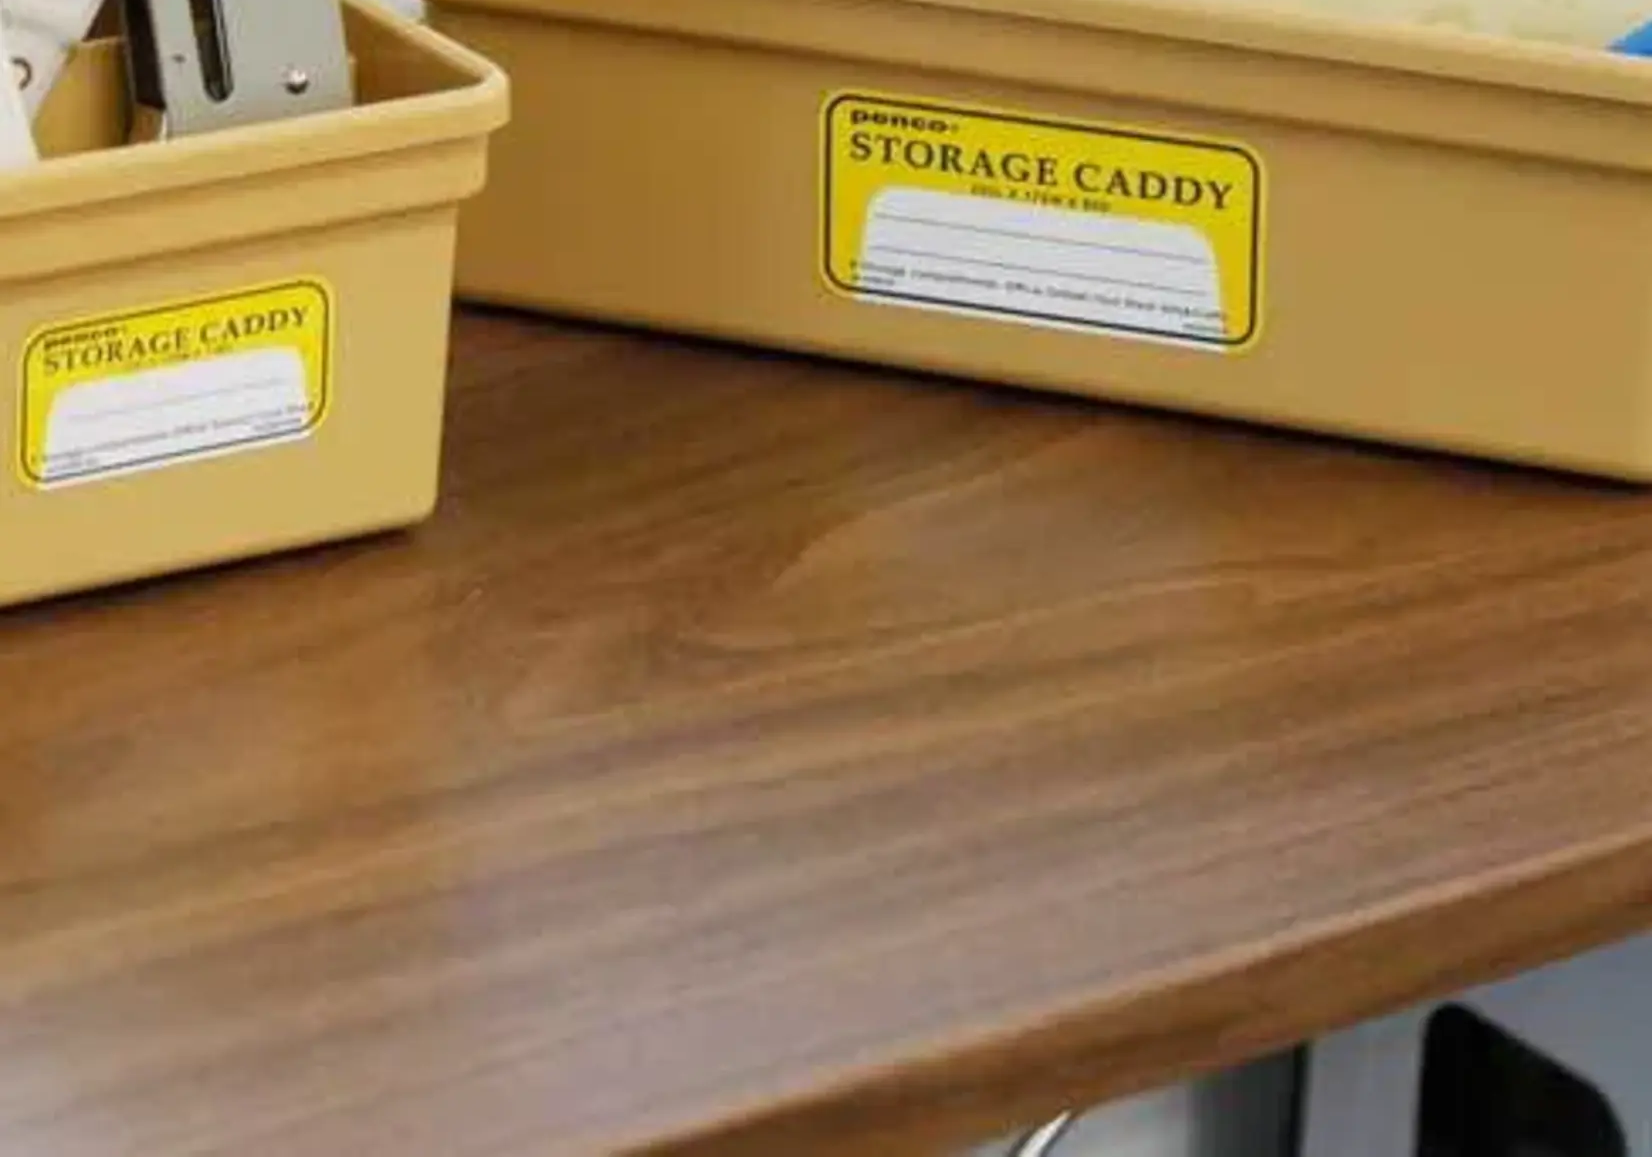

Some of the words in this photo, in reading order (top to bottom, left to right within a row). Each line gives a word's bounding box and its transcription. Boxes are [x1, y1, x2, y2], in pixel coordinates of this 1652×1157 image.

[850, 108, 949, 134] penco
[849, 131, 1059, 187] STORAGE
[1073, 164, 1233, 211] CADDY
[43, 327, 191, 377] STORAGE
[199, 304, 310, 345] CADDY
